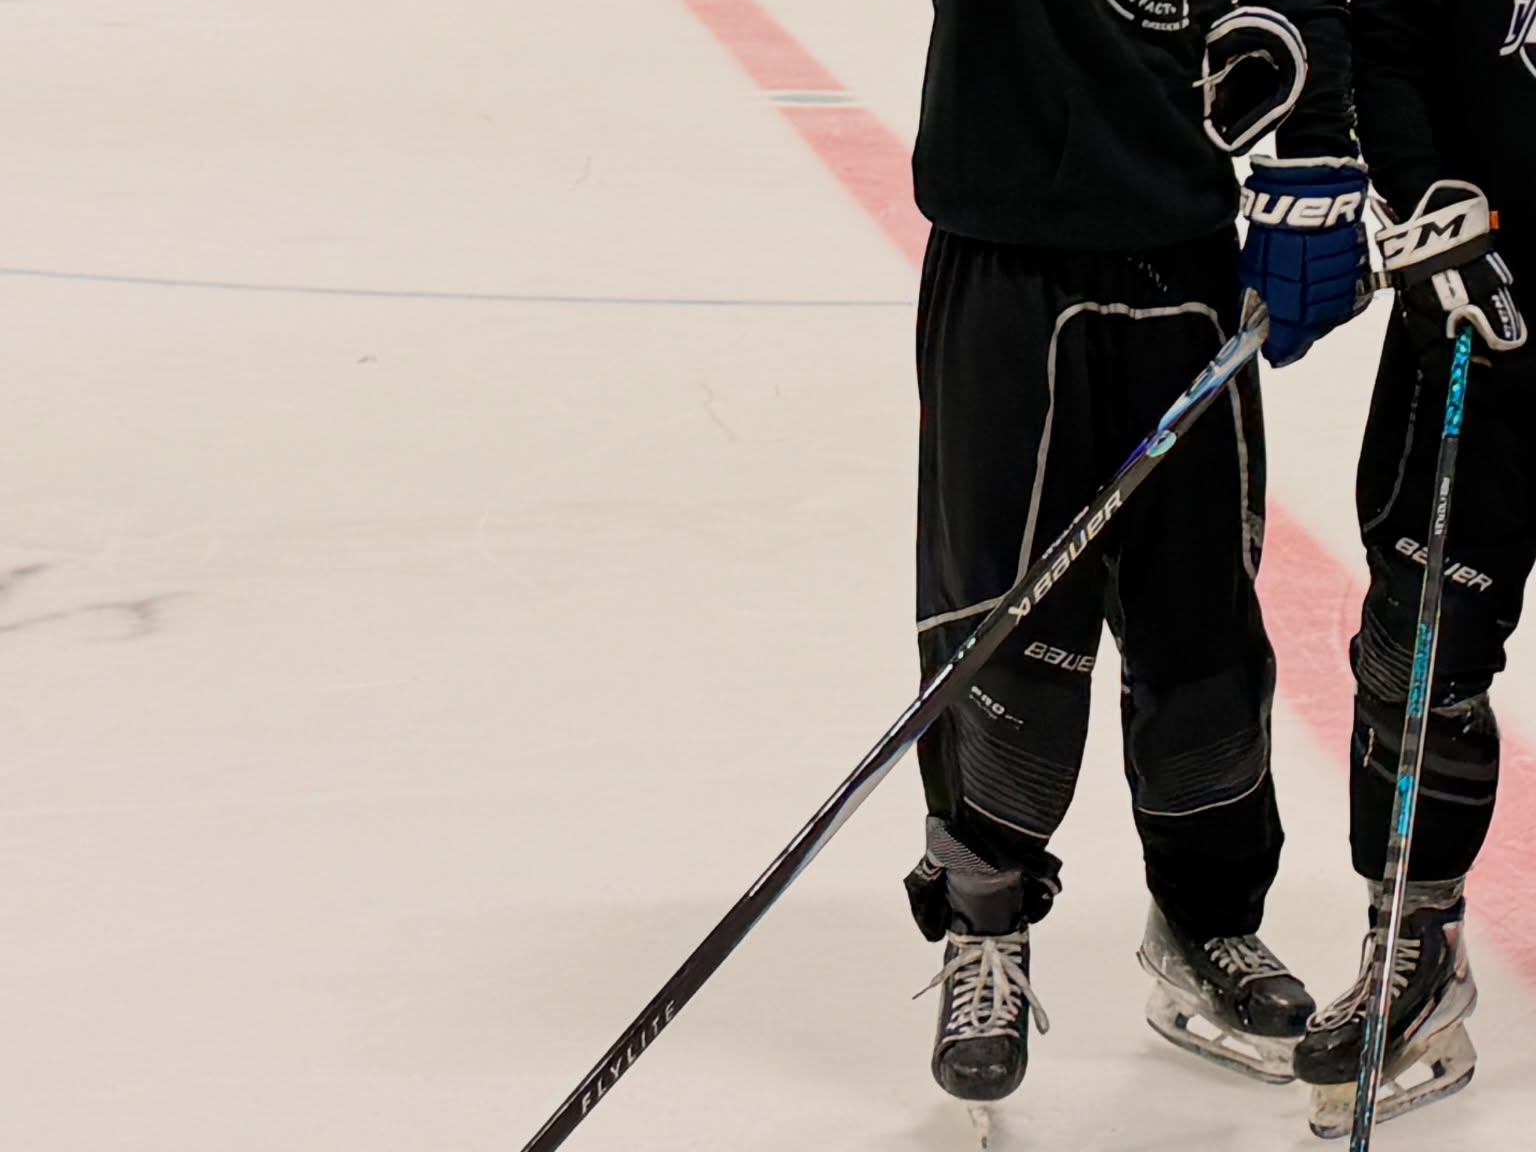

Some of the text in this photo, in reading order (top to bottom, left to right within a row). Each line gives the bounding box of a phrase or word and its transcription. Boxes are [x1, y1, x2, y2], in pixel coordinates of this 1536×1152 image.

[1240, 186, 1362, 227] UER
[1381, 213, 1467, 260] CM
[1032, 488, 1123, 605] BAUER
[1024, 641, 1096, 673] BAUE
[581, 999, 676, 1115] FLYLITE
